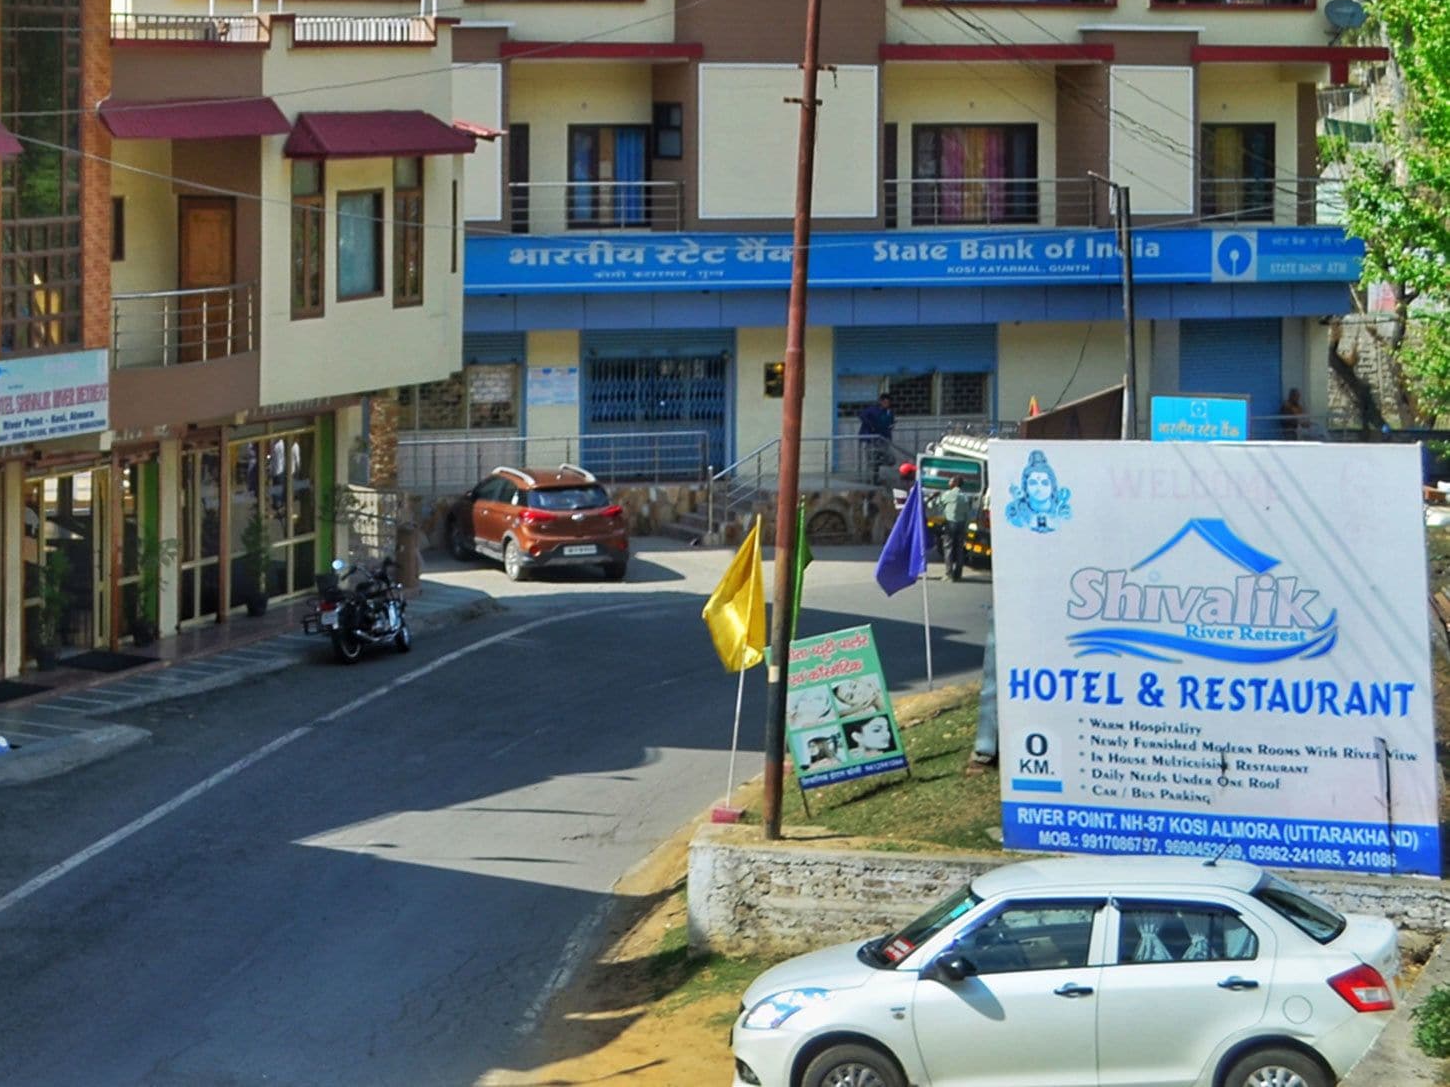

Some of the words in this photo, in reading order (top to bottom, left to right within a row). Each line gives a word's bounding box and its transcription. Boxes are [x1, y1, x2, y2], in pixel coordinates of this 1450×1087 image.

[509, 240, 645, 266] भारतीय
[655, 238, 726, 265] स्टेट
[872, 240, 948, 262] State
[960, 238, 1035, 261] Bank
[1044, 238, 1076, 260] of
[946, 265, 976, 275] KOSI
[1067, 567, 1320, 630] Shivalik
[1186, 623, 1235, 641] River
[1239, 624, 1307, 642] Retreat
[1009, 668, 1125, 705] HOTEL
[1137, 671, 1165, 708] &
[1177, 675, 1415, 717] RESTAURANT
[1019, 758, 1055, 775] KM.
[1017, 807, 1065, 826] RIVER
[1169, 817, 1208, 835] KOSI
[1211, 820, 1281, 841] ALMORA
[1284, 823, 1419, 852] (UTTARAKHAND)
[1039, 830, 1079, 848] MOB.:
